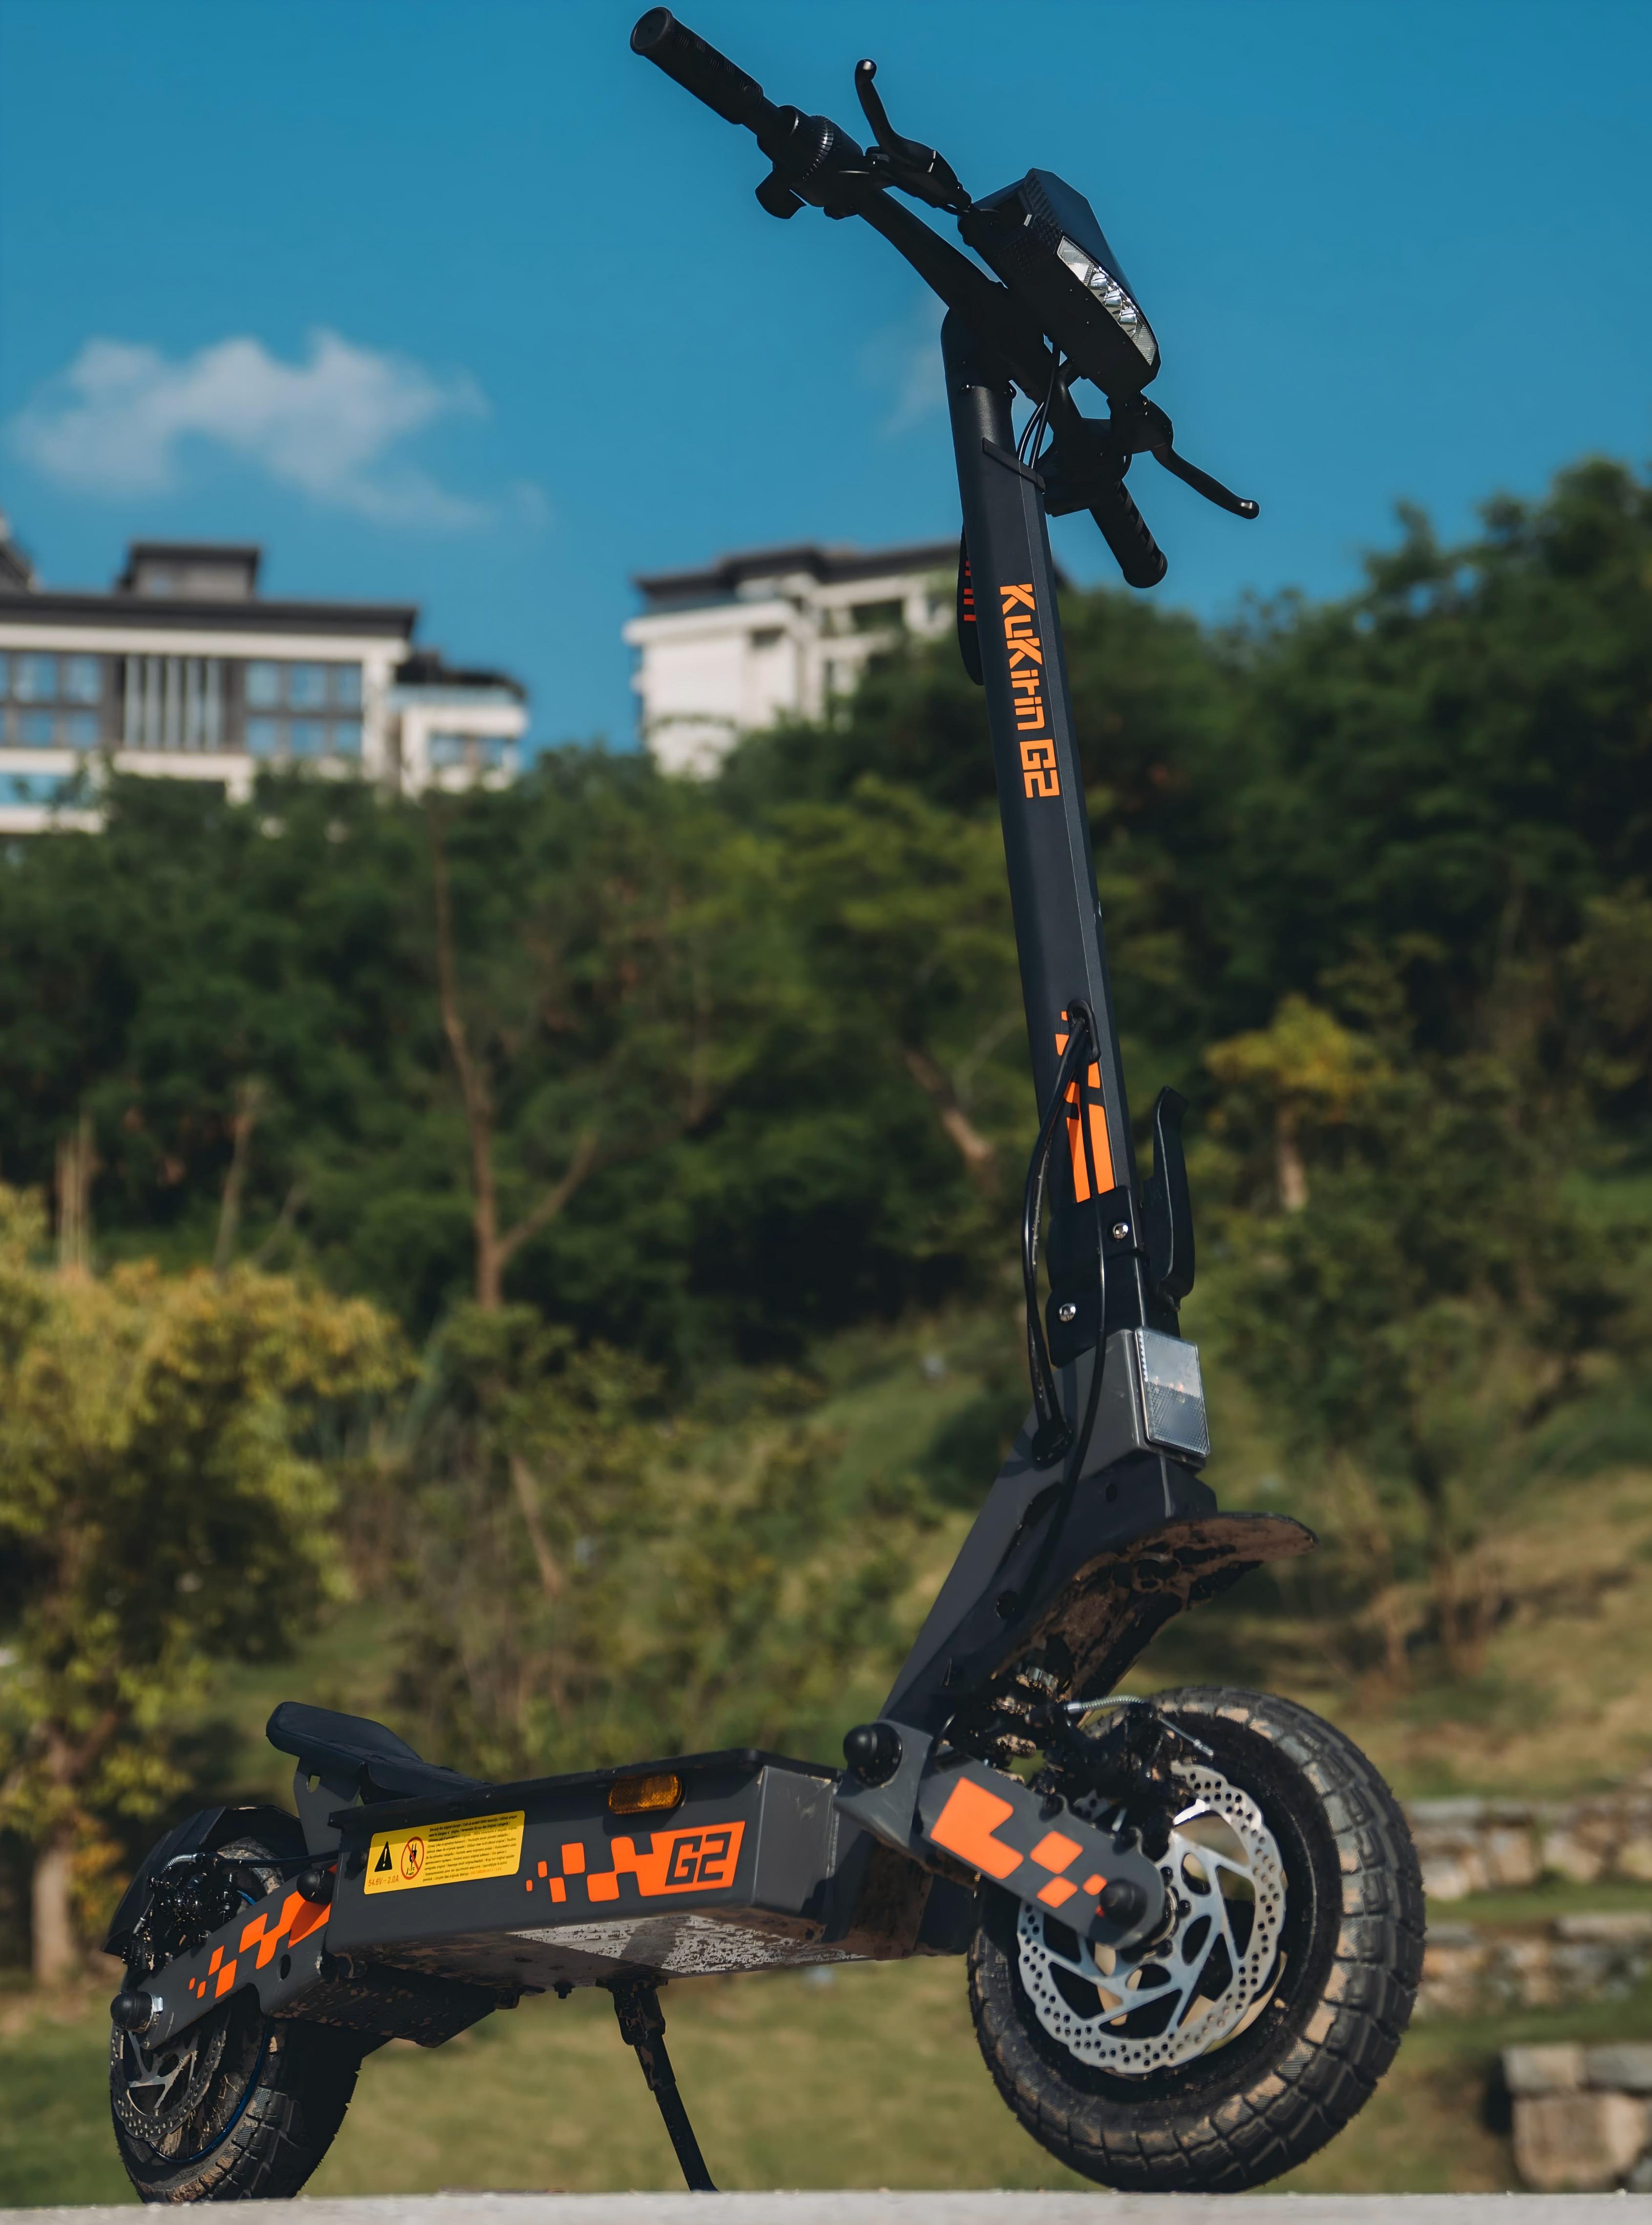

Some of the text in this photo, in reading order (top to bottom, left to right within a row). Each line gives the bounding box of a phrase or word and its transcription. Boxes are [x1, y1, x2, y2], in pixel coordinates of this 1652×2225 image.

[1000, 583, 1060, 798] KuKirin G2
[665, 1831, 732, 1886] G2
